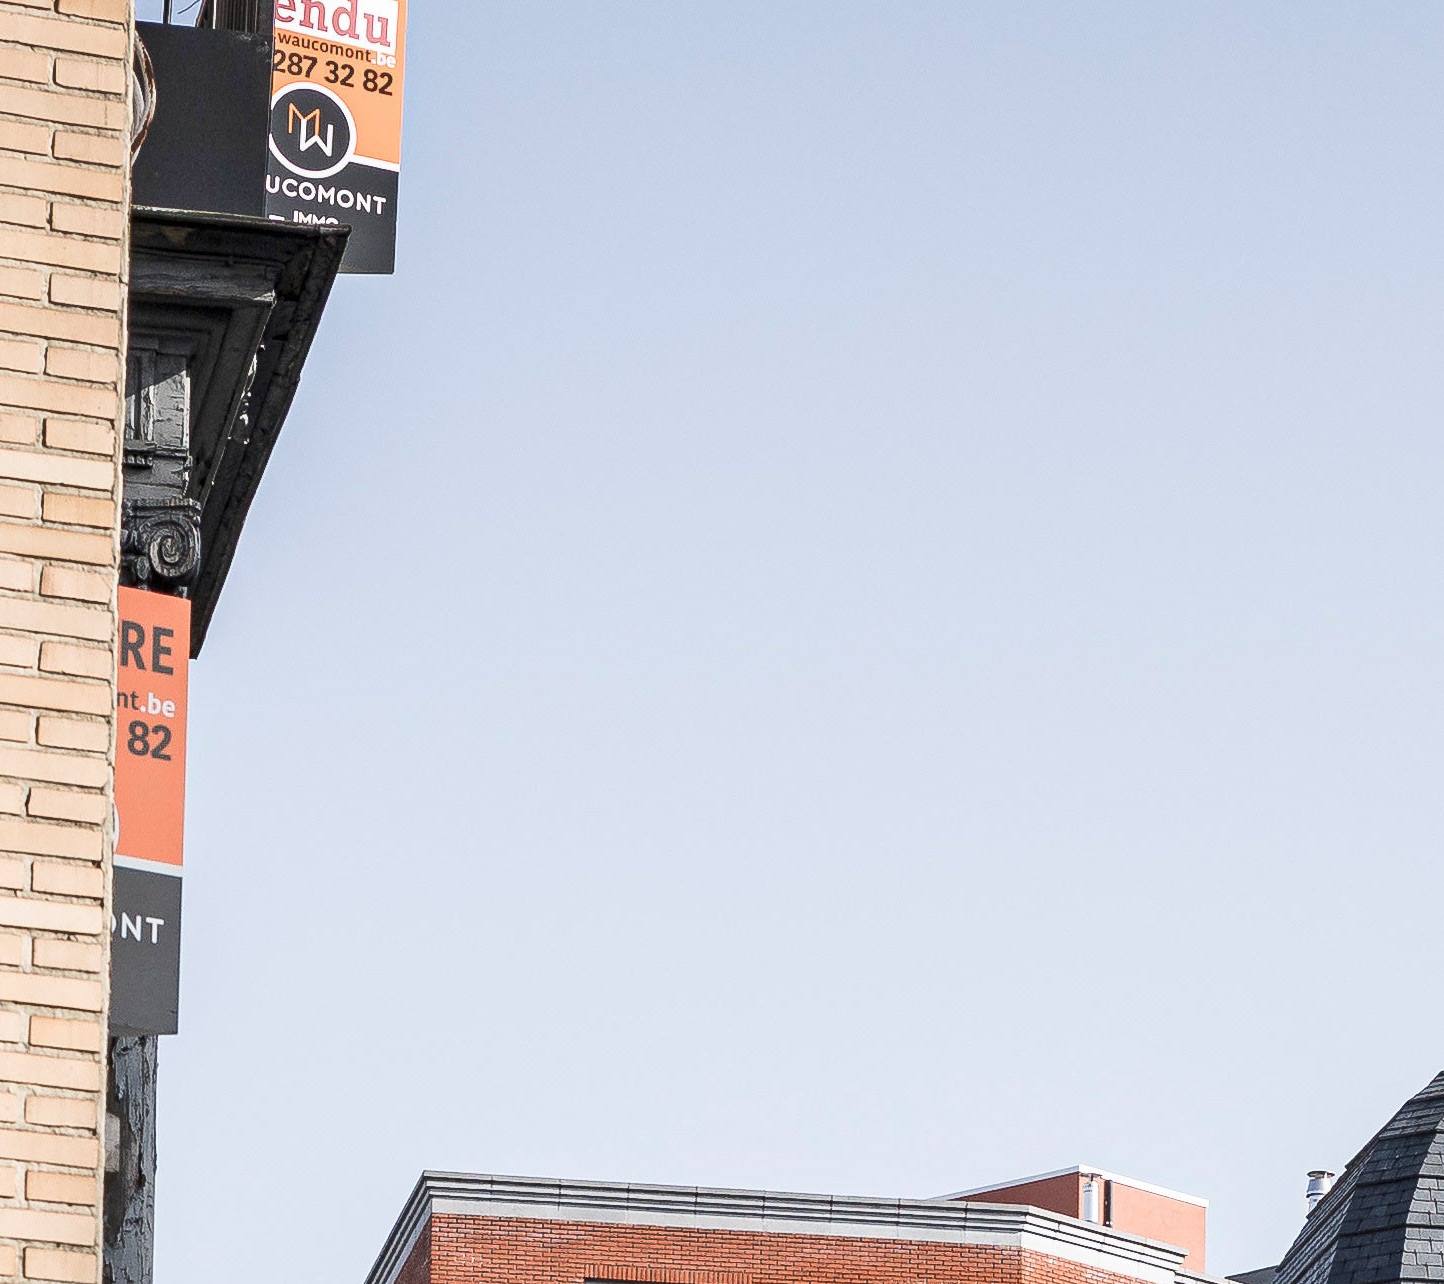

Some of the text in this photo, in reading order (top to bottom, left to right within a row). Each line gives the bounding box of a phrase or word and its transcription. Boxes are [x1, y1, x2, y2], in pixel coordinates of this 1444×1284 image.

[273, 49, 393, 96] 287 32 82
[265, 174, 387, 215] UCOMONT
[121, 619, 175, 676] RE
[128, 720, 172, 761] 82
[111, 911, 165, 945] NT
